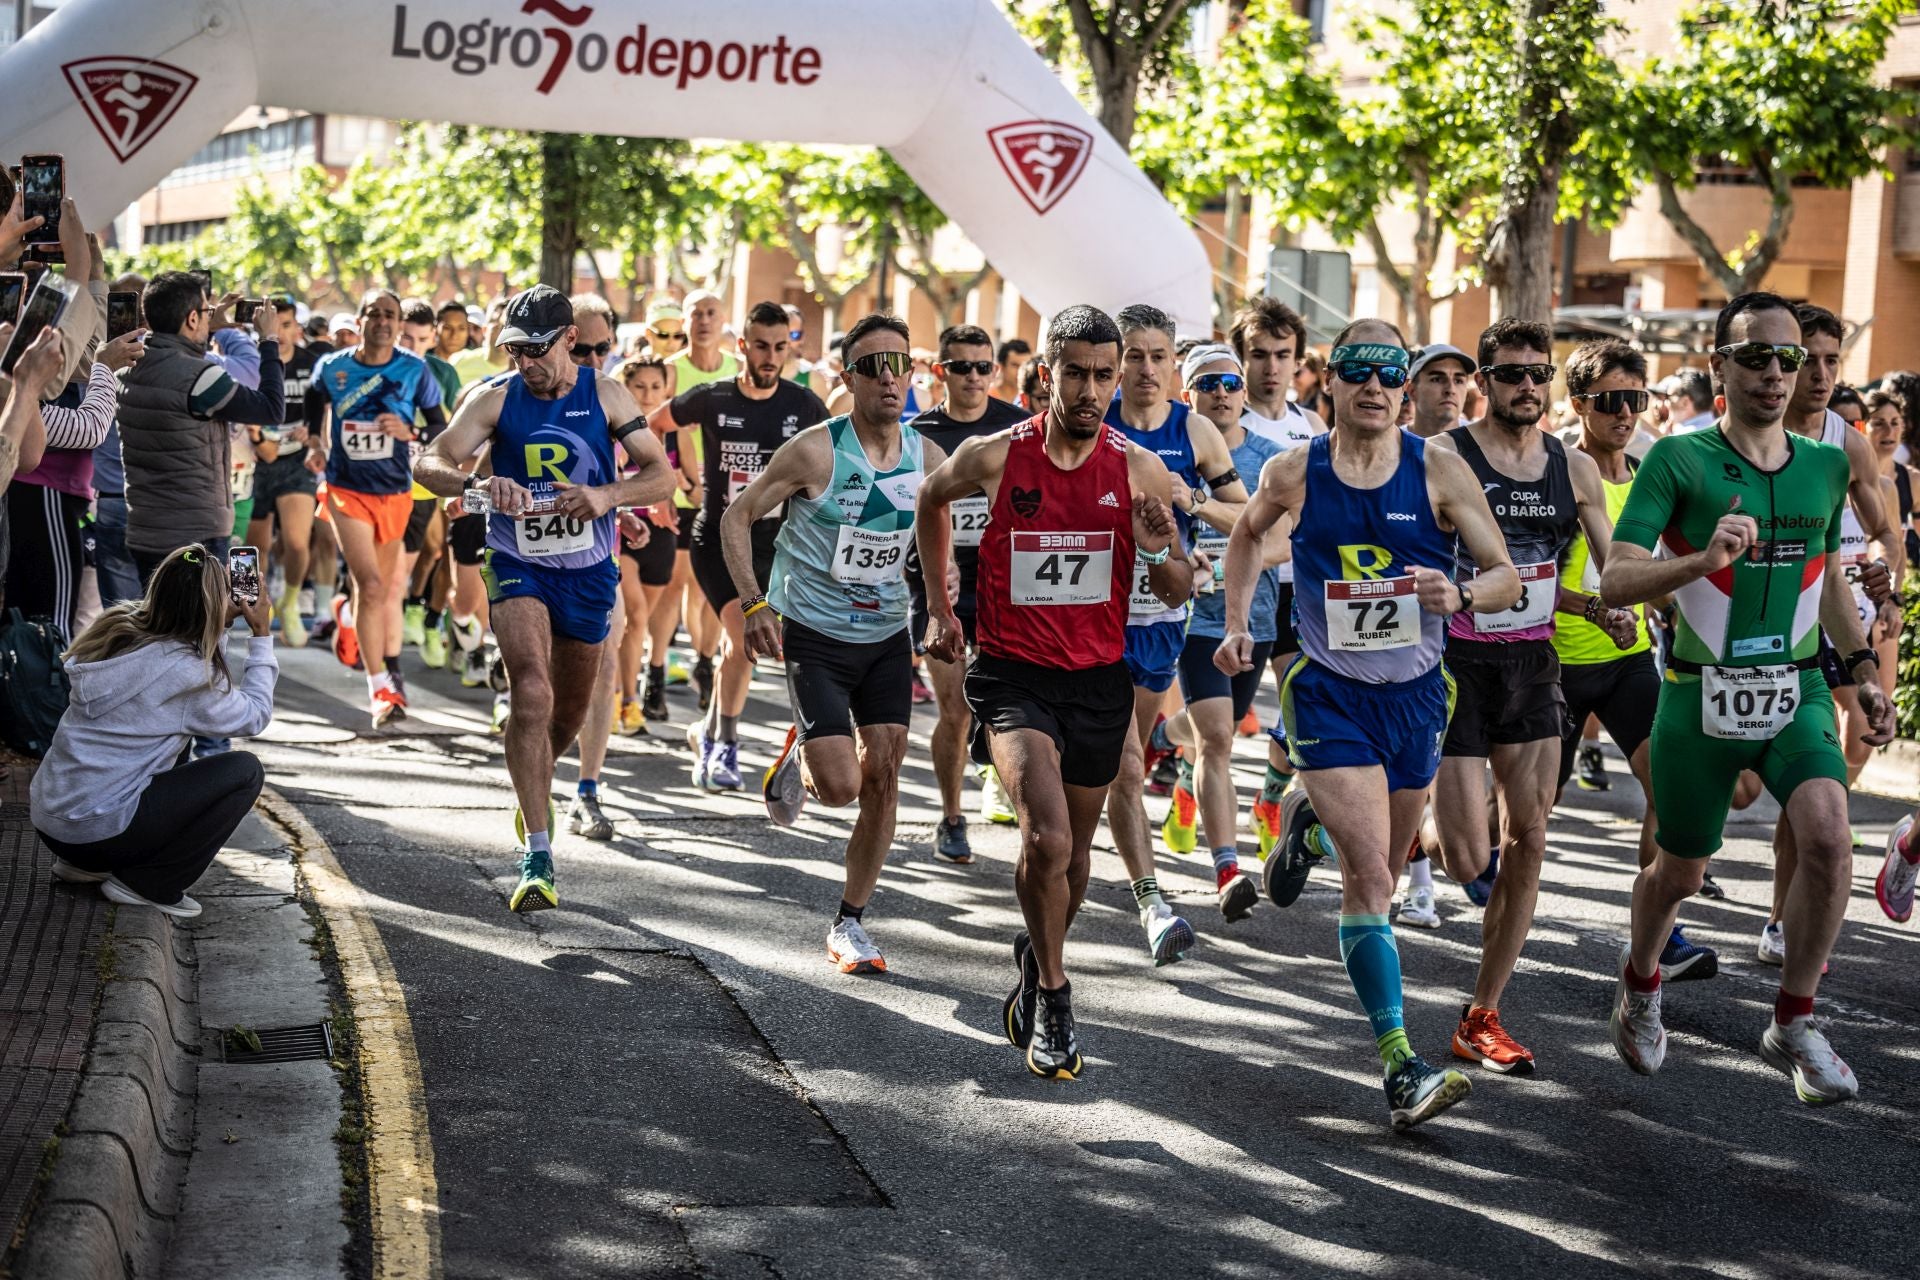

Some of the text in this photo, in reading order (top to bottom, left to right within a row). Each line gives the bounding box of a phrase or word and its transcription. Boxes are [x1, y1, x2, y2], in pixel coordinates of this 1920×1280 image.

[392, 0, 821, 95] Logroño deporte
[1354, 346, 1397, 361] NIKE
[347, 434, 385, 450] 411
[524, 443, 571, 484] R
[721, 453, 762, 465] CROSS
[528, 482, 554, 492] CLUB
[1098, 499, 1119, 507] adidas
[1495, 505, 1557, 517] O BARCO
[525, 513, 585, 542] 540
[853, 531, 891, 543] CARRERA
[841, 544, 901, 569] 1359
[1338, 544, 1393, 580] R
[1035, 554, 1090, 586] 47
[1347, 600, 1400, 632] 72
[1358, 630, 1392, 640] RUBÉN
[1720, 672, 1775, 681] CARRERA
[1711, 688, 1795, 717] 1075
[1738, 721, 1773, 729] SERGIO
